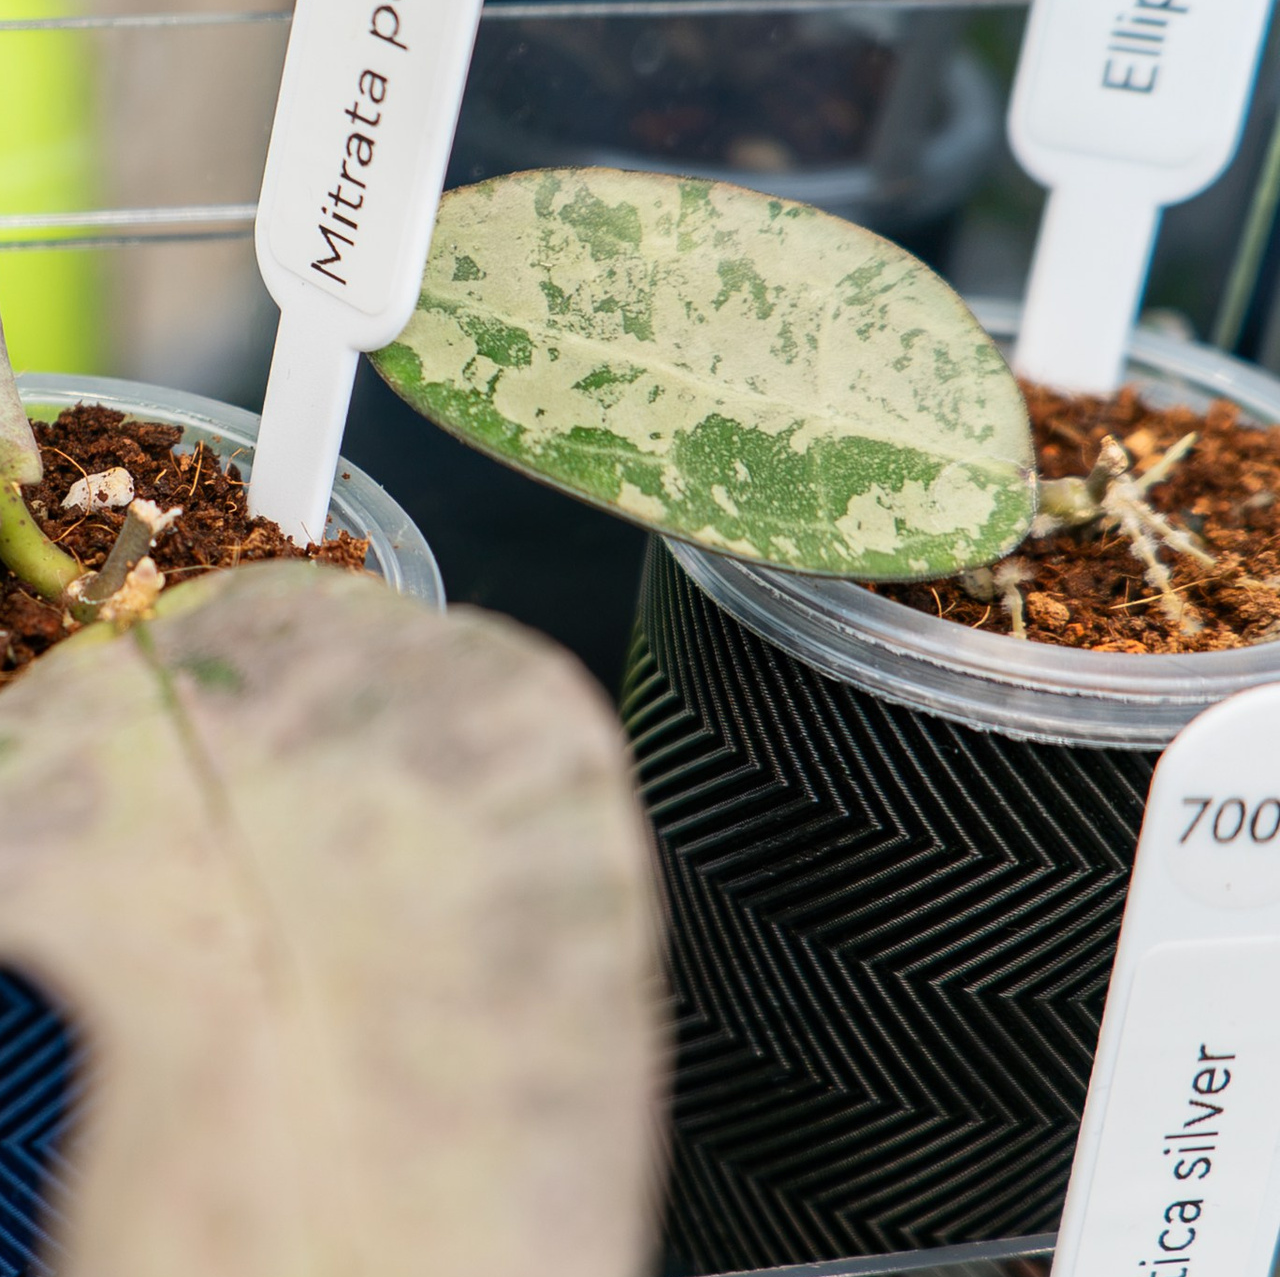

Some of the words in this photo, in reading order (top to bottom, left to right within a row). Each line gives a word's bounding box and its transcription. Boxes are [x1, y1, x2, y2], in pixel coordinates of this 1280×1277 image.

[310, 67, 389, 286] Mitrata
[1179, 797, 1280, 844] 700
[1163, 1042, 1237, 1181] silver
